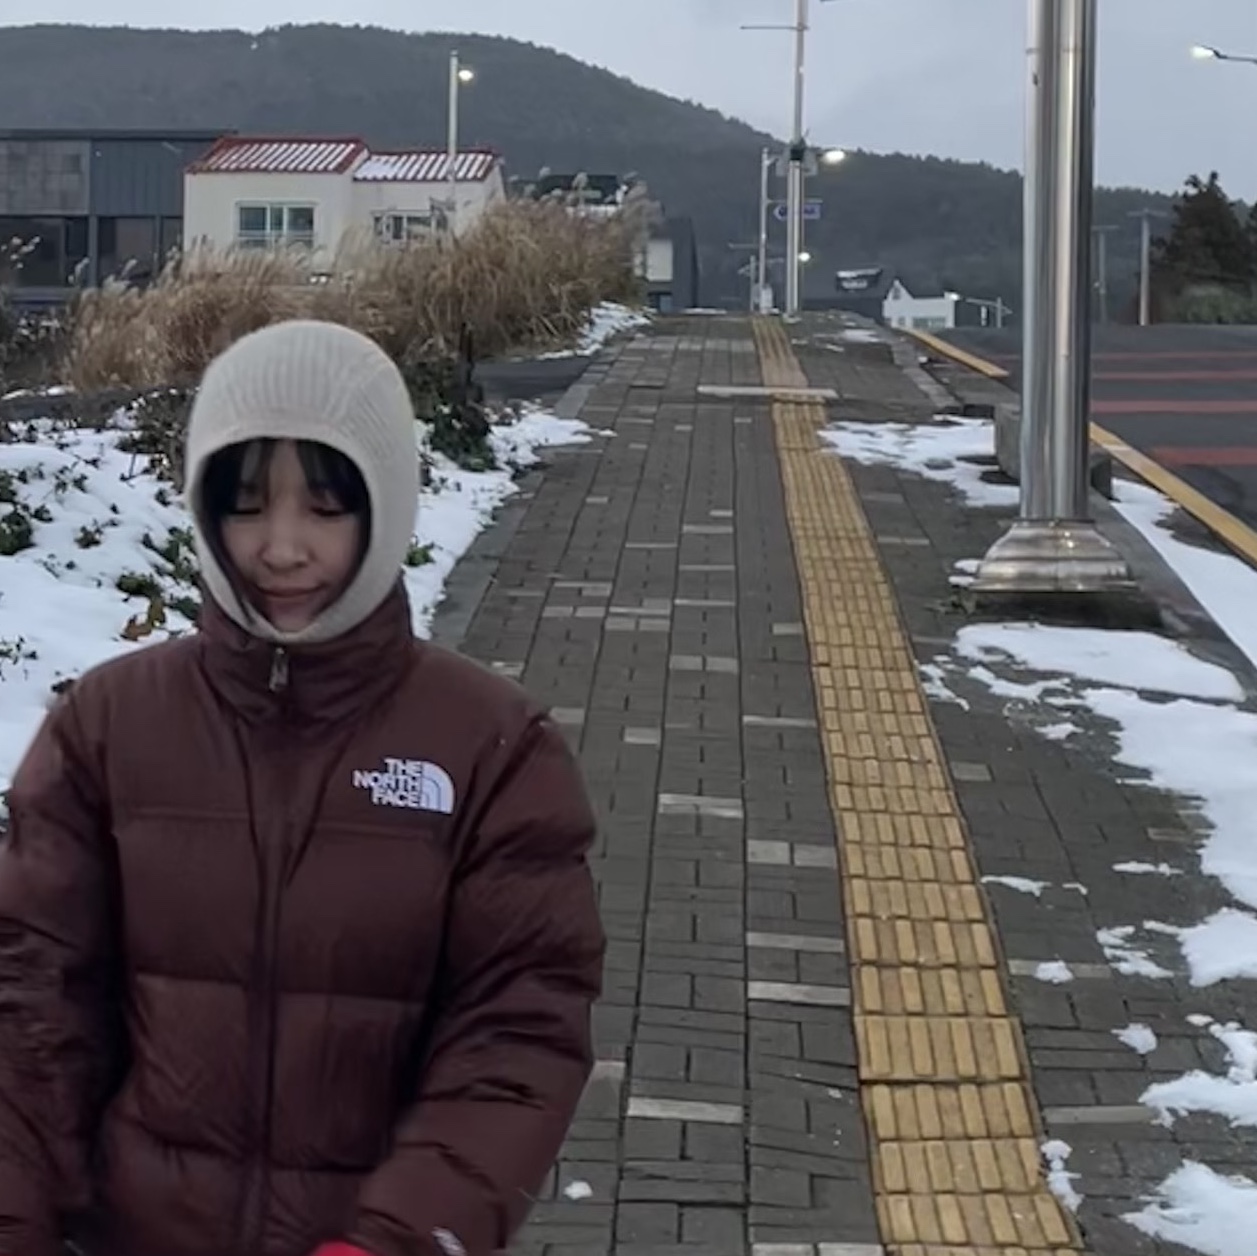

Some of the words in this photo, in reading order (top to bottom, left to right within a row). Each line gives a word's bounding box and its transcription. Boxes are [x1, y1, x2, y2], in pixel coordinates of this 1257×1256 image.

[384, 758, 422, 776] THE
[352, 769, 422, 793] NORTH
[371, 787, 422, 808] FACE
